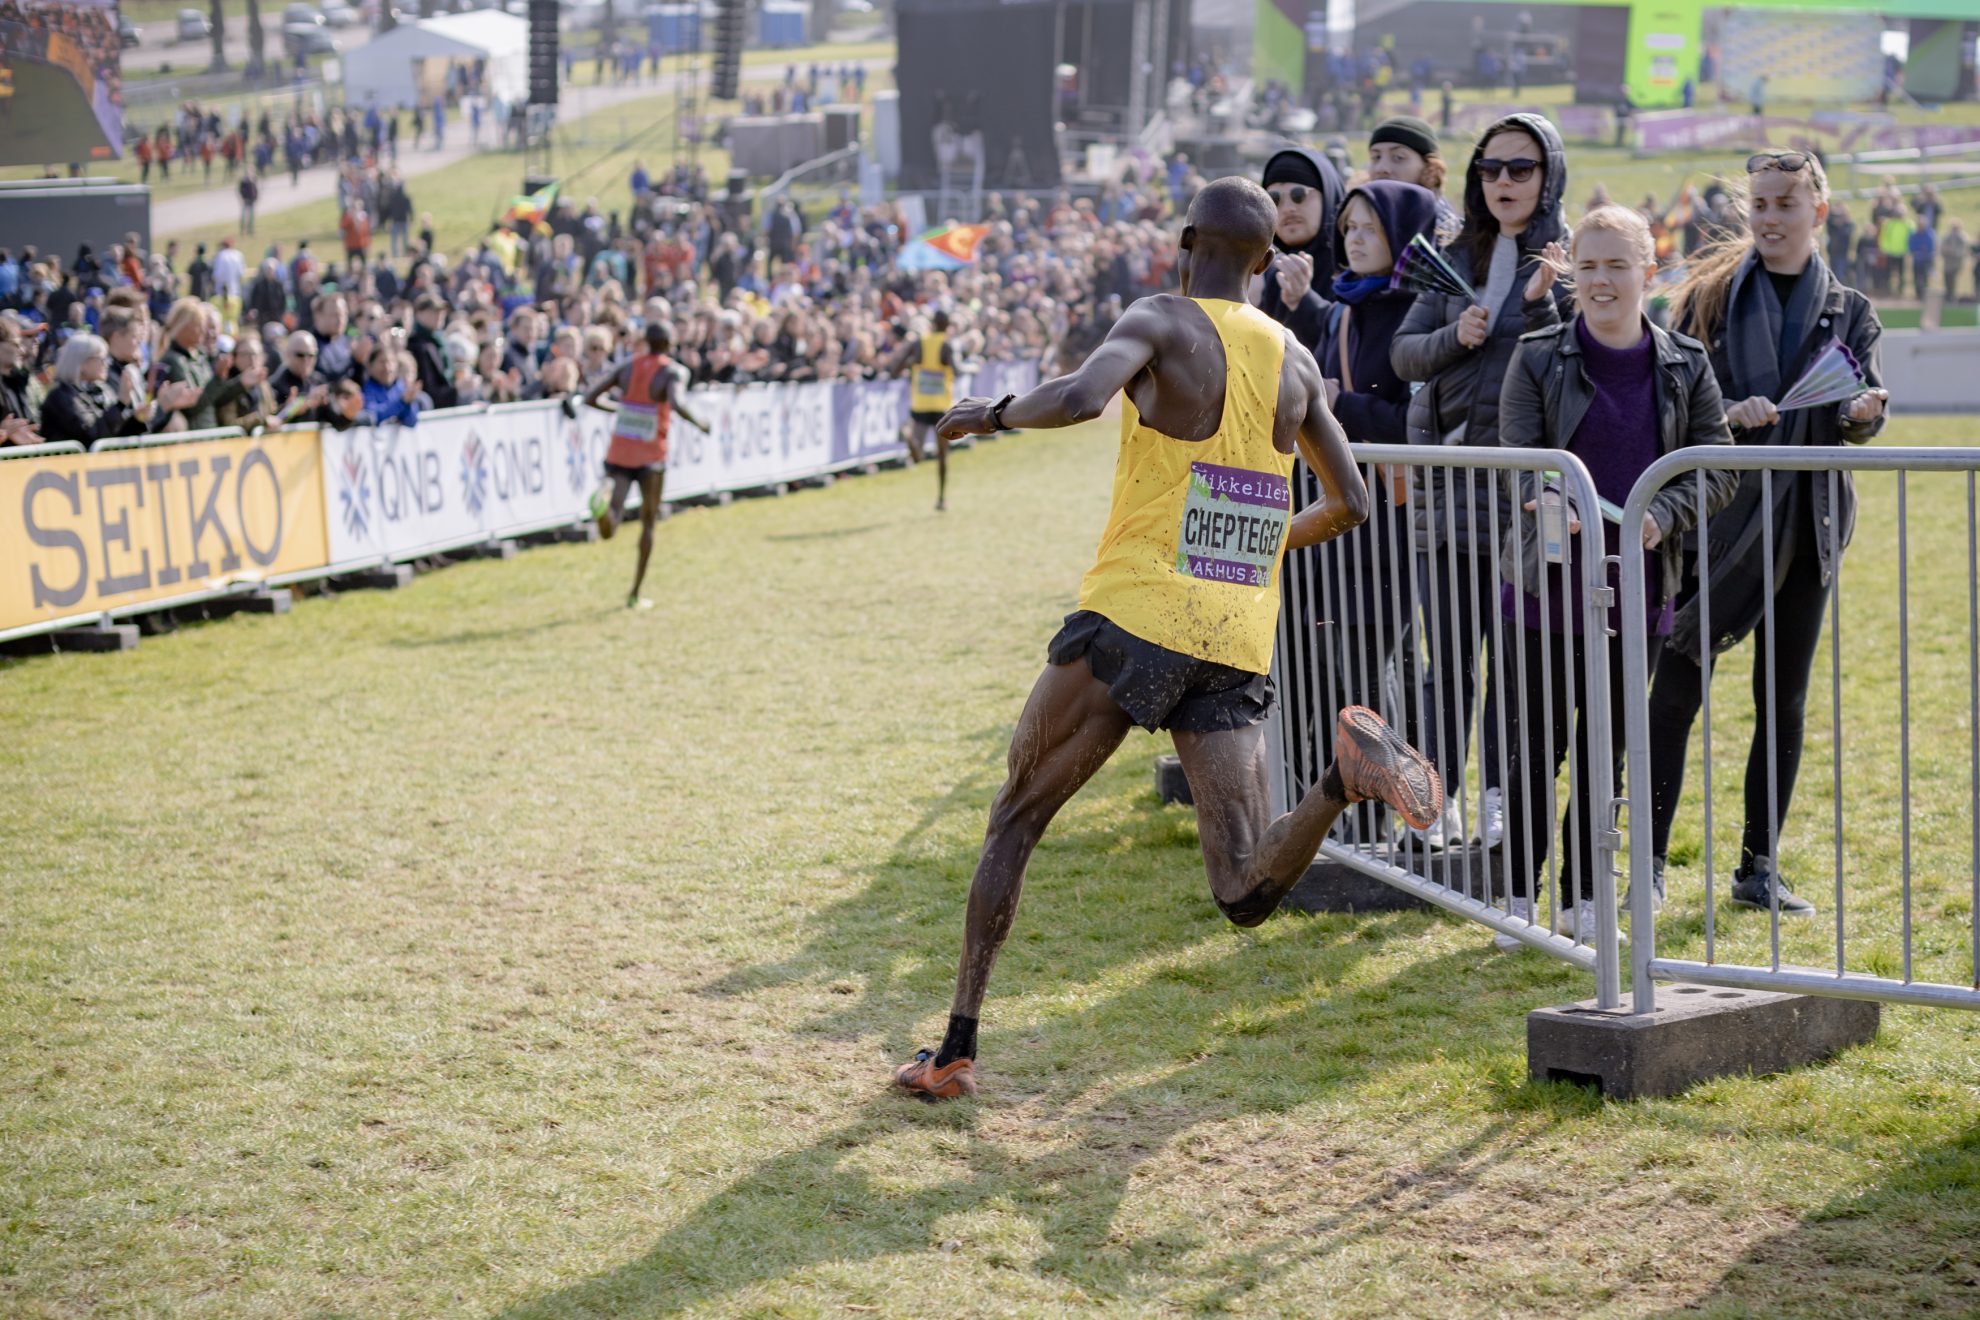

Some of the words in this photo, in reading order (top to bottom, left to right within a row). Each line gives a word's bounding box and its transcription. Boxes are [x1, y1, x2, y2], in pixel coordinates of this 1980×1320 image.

[378, 451, 444, 522] QNB
[492, 437, 545, 501] QNB
[1193, 471, 1289, 502] Mikkeller
[22, 448, 282, 608] SEIKO
[1182, 560, 1247, 582] AARHUS
